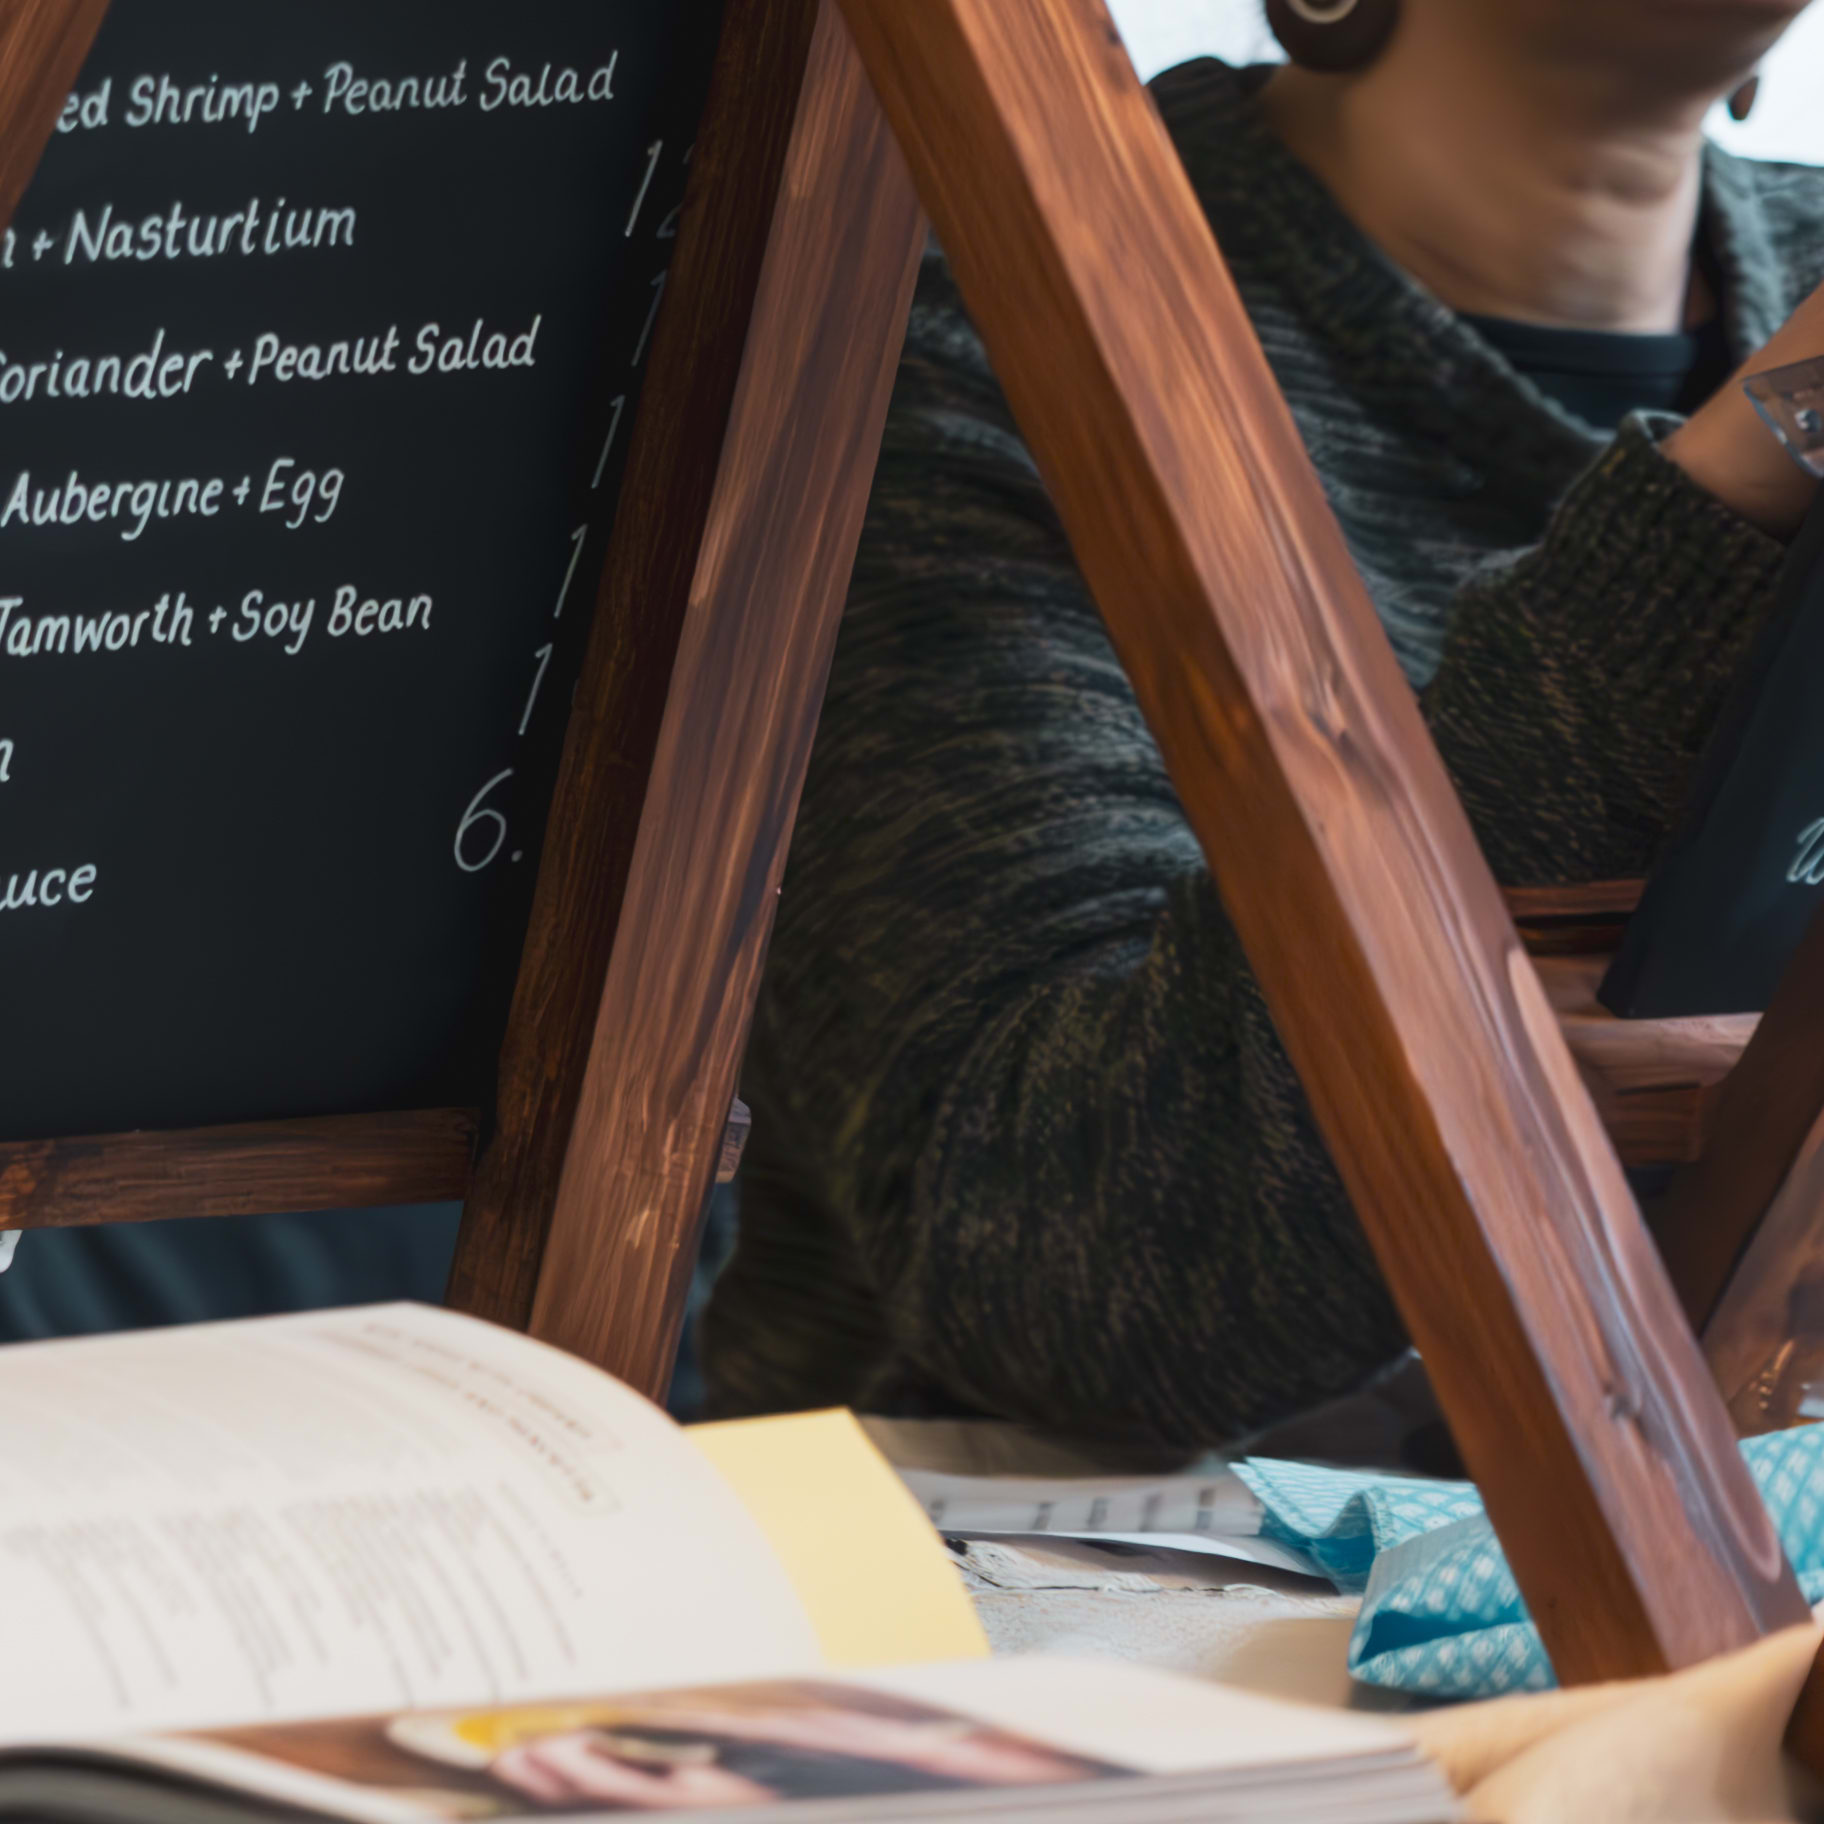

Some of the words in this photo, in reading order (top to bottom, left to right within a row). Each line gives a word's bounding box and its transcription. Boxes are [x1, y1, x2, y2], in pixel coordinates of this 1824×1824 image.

[125, 74, 280, 134] Shrimp
[323, 60, 468, 115] Peanut
[479, 50, 619, 112] Salad
[64, 197, 356, 265] Nasturtium
[247, 325, 400, 386] Peanut
[407, 314, 542, 375] Salad
[0, 470, 224, 542] Aubergine
[259, 457, 345, 530] Egg
[228, 589, 316, 655] Soy
[326, 584, 433, 637] Bean
